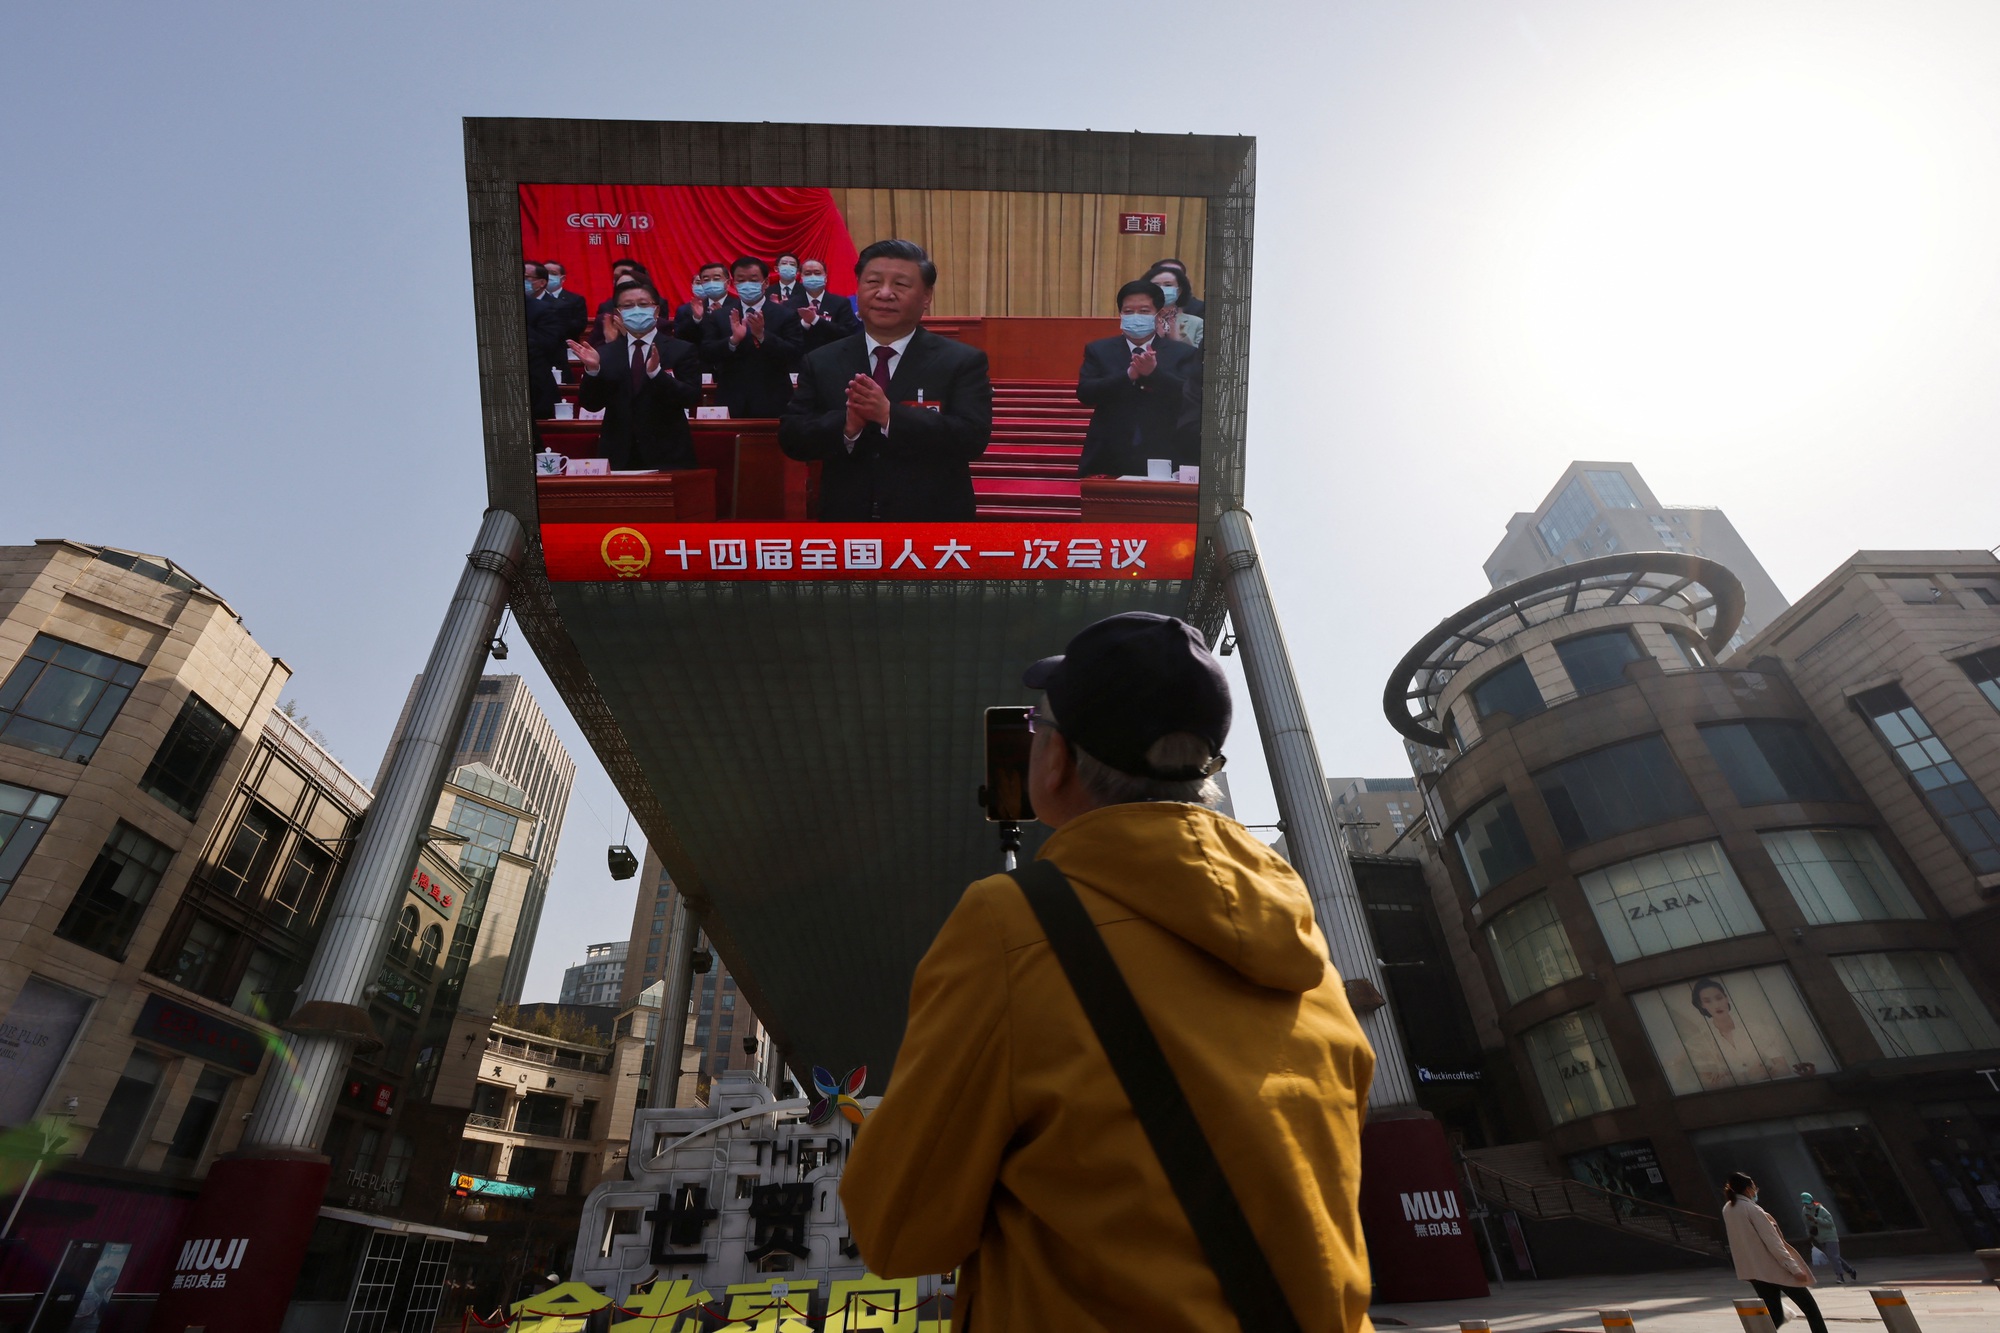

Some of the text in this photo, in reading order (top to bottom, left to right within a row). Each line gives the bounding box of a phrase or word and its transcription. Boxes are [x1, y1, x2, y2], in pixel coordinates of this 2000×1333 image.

[566, 213, 649, 229] CCTV 13
[1125, 216, 1161, 232] 直播
[589, 233, 630, 245] 新闻
[665, 538, 1147, 570] 十四届全国人大一次会议
[1628, 893, 1702, 921] ZARA
[1878, 1005, 1949, 1022] ZARA
[1431, 1070, 1475, 1080] luckincoffee
[1562, 1057, 1606, 1080] ZARA
[1976, 1068, 2000, 1092] T
[750, 1139, 814, 1166] THE
[347, 1169, 400, 1194] THE PLACE
[1400, 1190, 1460, 1221] MUJI
[645, 1183, 859, 1265] 世贸
[1414, 1222, 1462, 1237] 無印良品
[175, 1238, 250, 1271] MUJI
[172, 1273, 226, 1290] 無印良品
[510, 1271, 958, 1333] 全北京向
